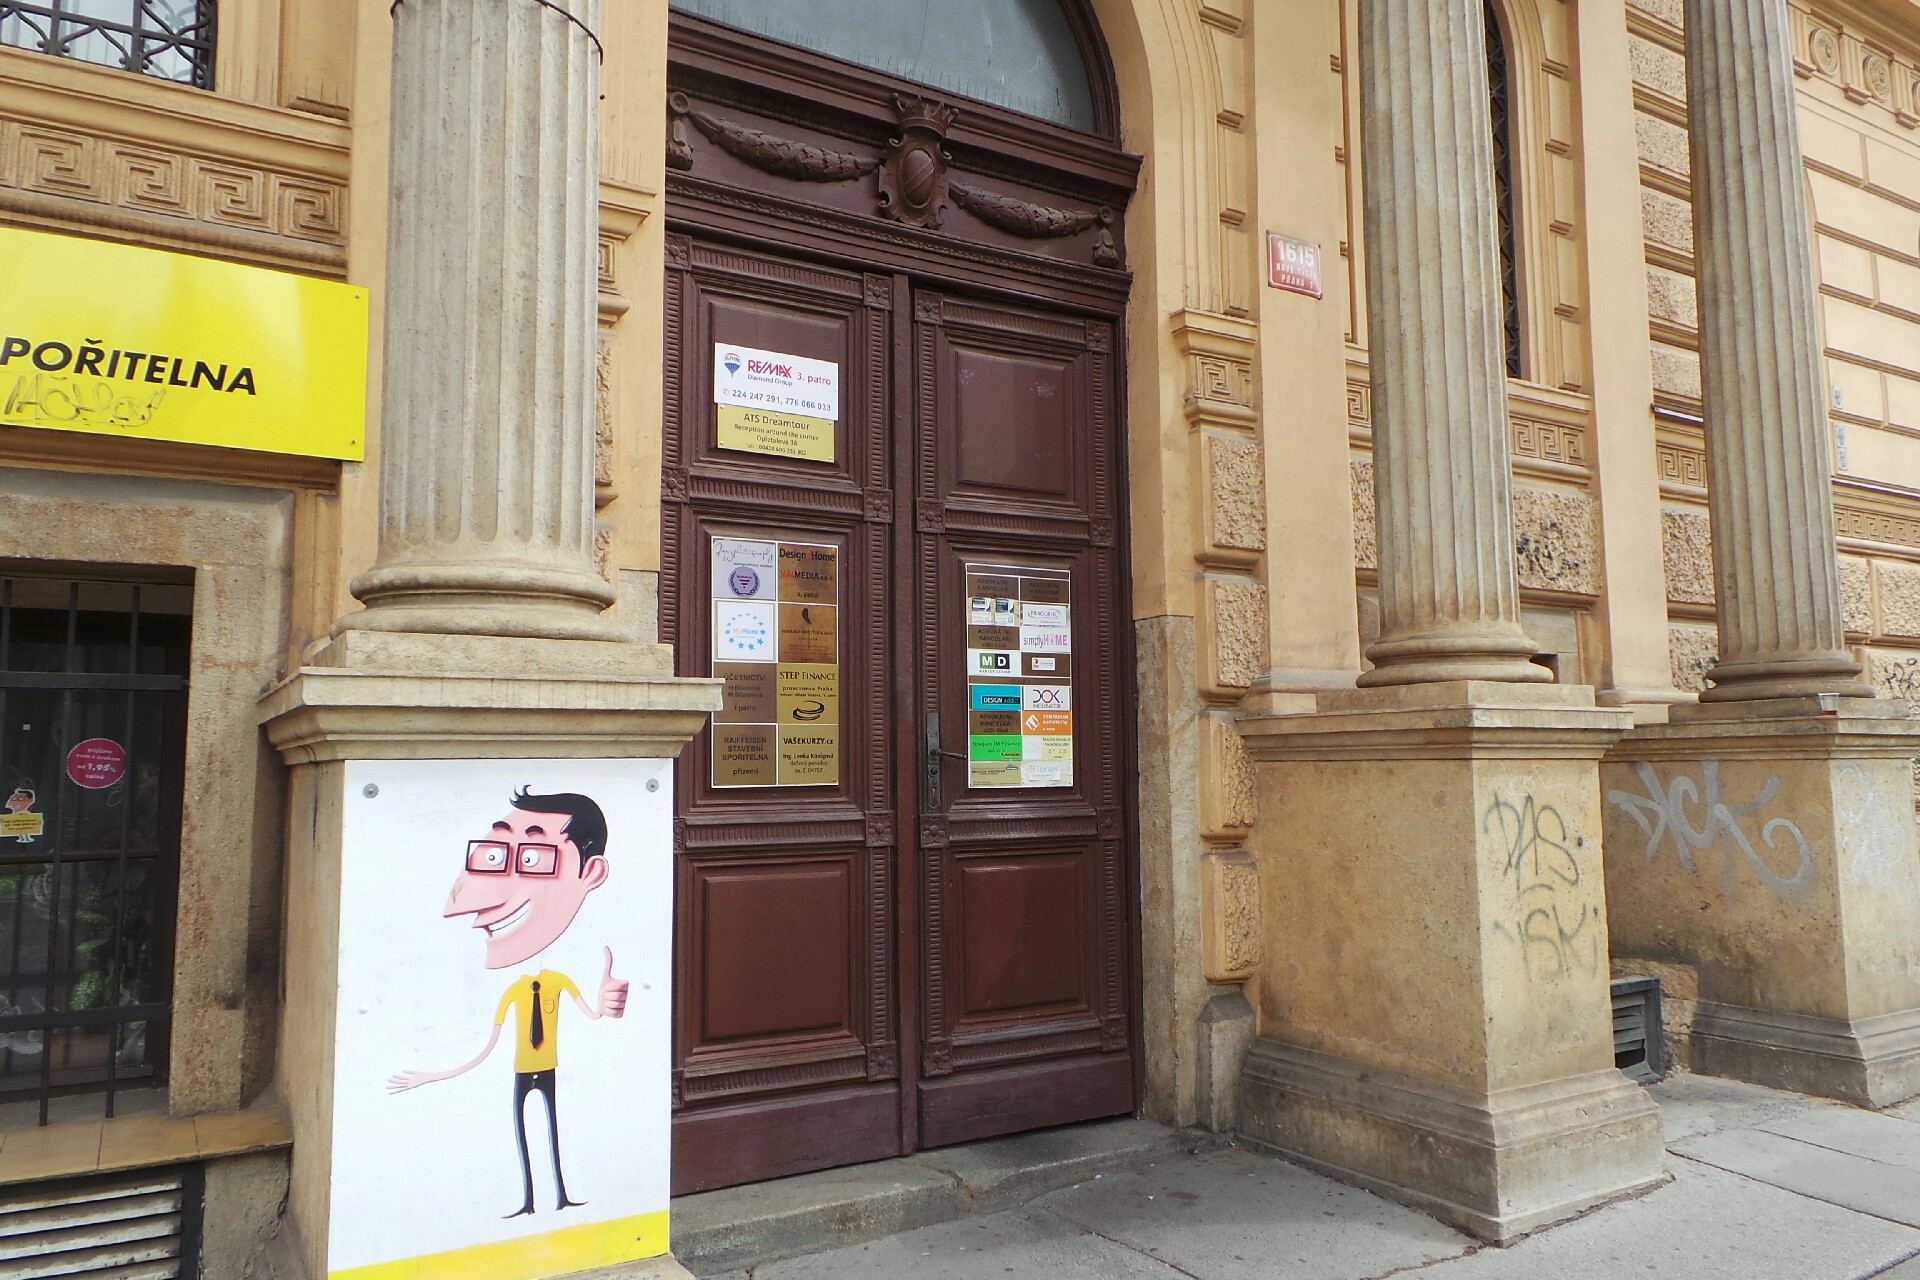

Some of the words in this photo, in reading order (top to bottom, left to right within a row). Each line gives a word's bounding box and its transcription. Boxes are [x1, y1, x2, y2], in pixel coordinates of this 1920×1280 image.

[1278, 240, 1314, 267] 1615
[1276, 262, 1294, 274] NOVÉ
[1282, 274, 1304, 287] PRAHA
[1310, 280, 1314, 289] 1
[748, 374, 774, 384] Diamond
[774, 378, 792, 387] Group
[808, 374, 832, 386] patro
[732, 390, 746, 398] 224
[750, 392, 763, 400] 247
[785, 398, 800, 406] 776
[802, 400, 816, 408] 066
[818, 402, 831, 412] 033
[744, 414, 760, 423] ATS
[762, 416, 810, 430] Dreamtour
[734, 424, 764, 434] Reception
[766, 428, 787, 436] around
[788, 430, 798, 438] the
[800, 432, 818, 440] corner
[756, 436, 788, 446] Opletalova
[780, 570, 819, 580] VALMEDIA
[780, 672, 800, 680] STEP
[783, 736, 834, 745] VAŠEKURZY.cz
[728, 744, 764, 752] STAVEBNÍ
